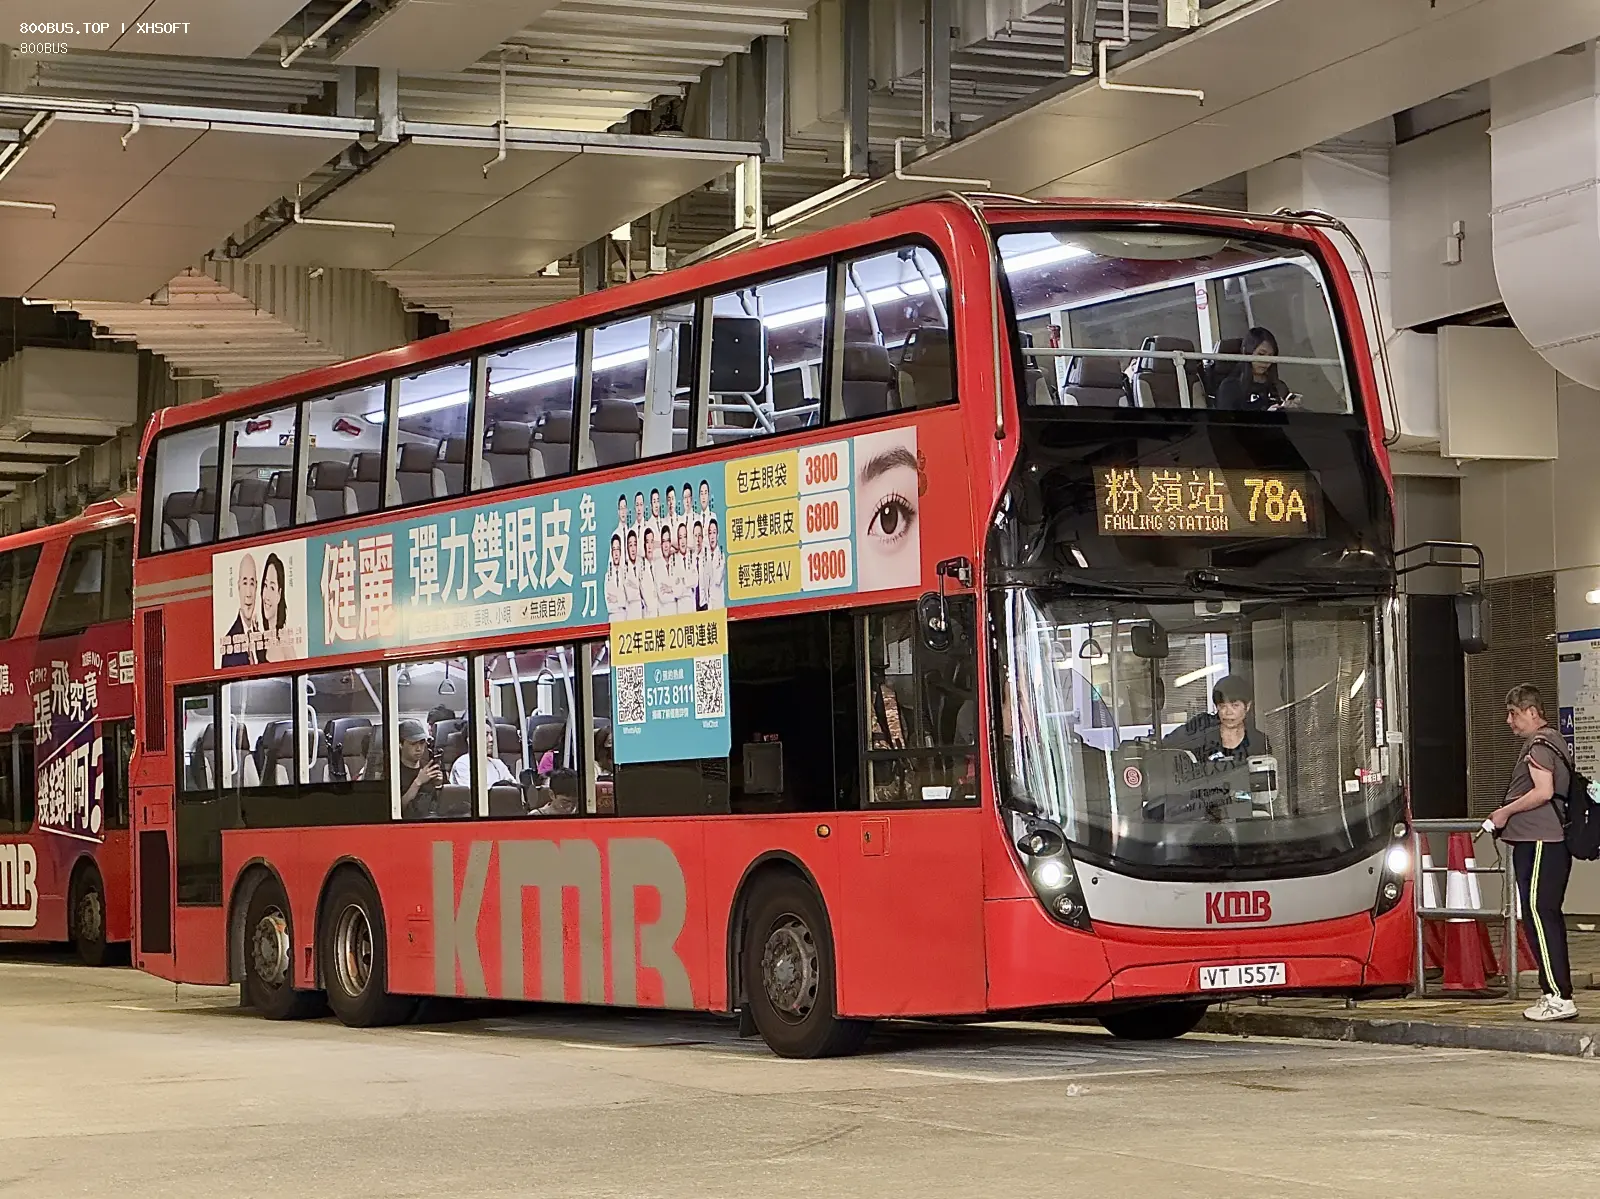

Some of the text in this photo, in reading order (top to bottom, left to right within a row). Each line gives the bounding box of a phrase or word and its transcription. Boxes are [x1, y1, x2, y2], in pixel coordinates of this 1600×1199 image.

[737, 463, 787, 493] 包去眼袋
[805, 451, 838, 485] 3800
[1104, 468, 1225, 513] 粉嶺站
[1243, 478, 1307, 522] 78A
[731, 509, 795, 541] 彈力雙眼皮
[806, 500, 839, 533] 6800
[1104, 514, 1230, 531] FANLING STATION
[408, 498, 574, 606] 彈力雙眼皮
[579, 492, 597, 618] 免開刀
[807, 548, 846, 582] 19800
[320, 534, 394, 645] 健麗
[738, 560, 791, 588] 輕薄眼4V
[530, 598, 566, 620] 無痕自然
[618, 621, 719, 655] 22年品牌 20間連鎖
[33, 660, 98, 746] 張飛究竟
[647, 684, 694, 706] 5173 8111
[1566, 714, 1574, 729] A
[1205, 890, 1272, 924] KMB
[1206, 965, 1277, 986] VT 1557
